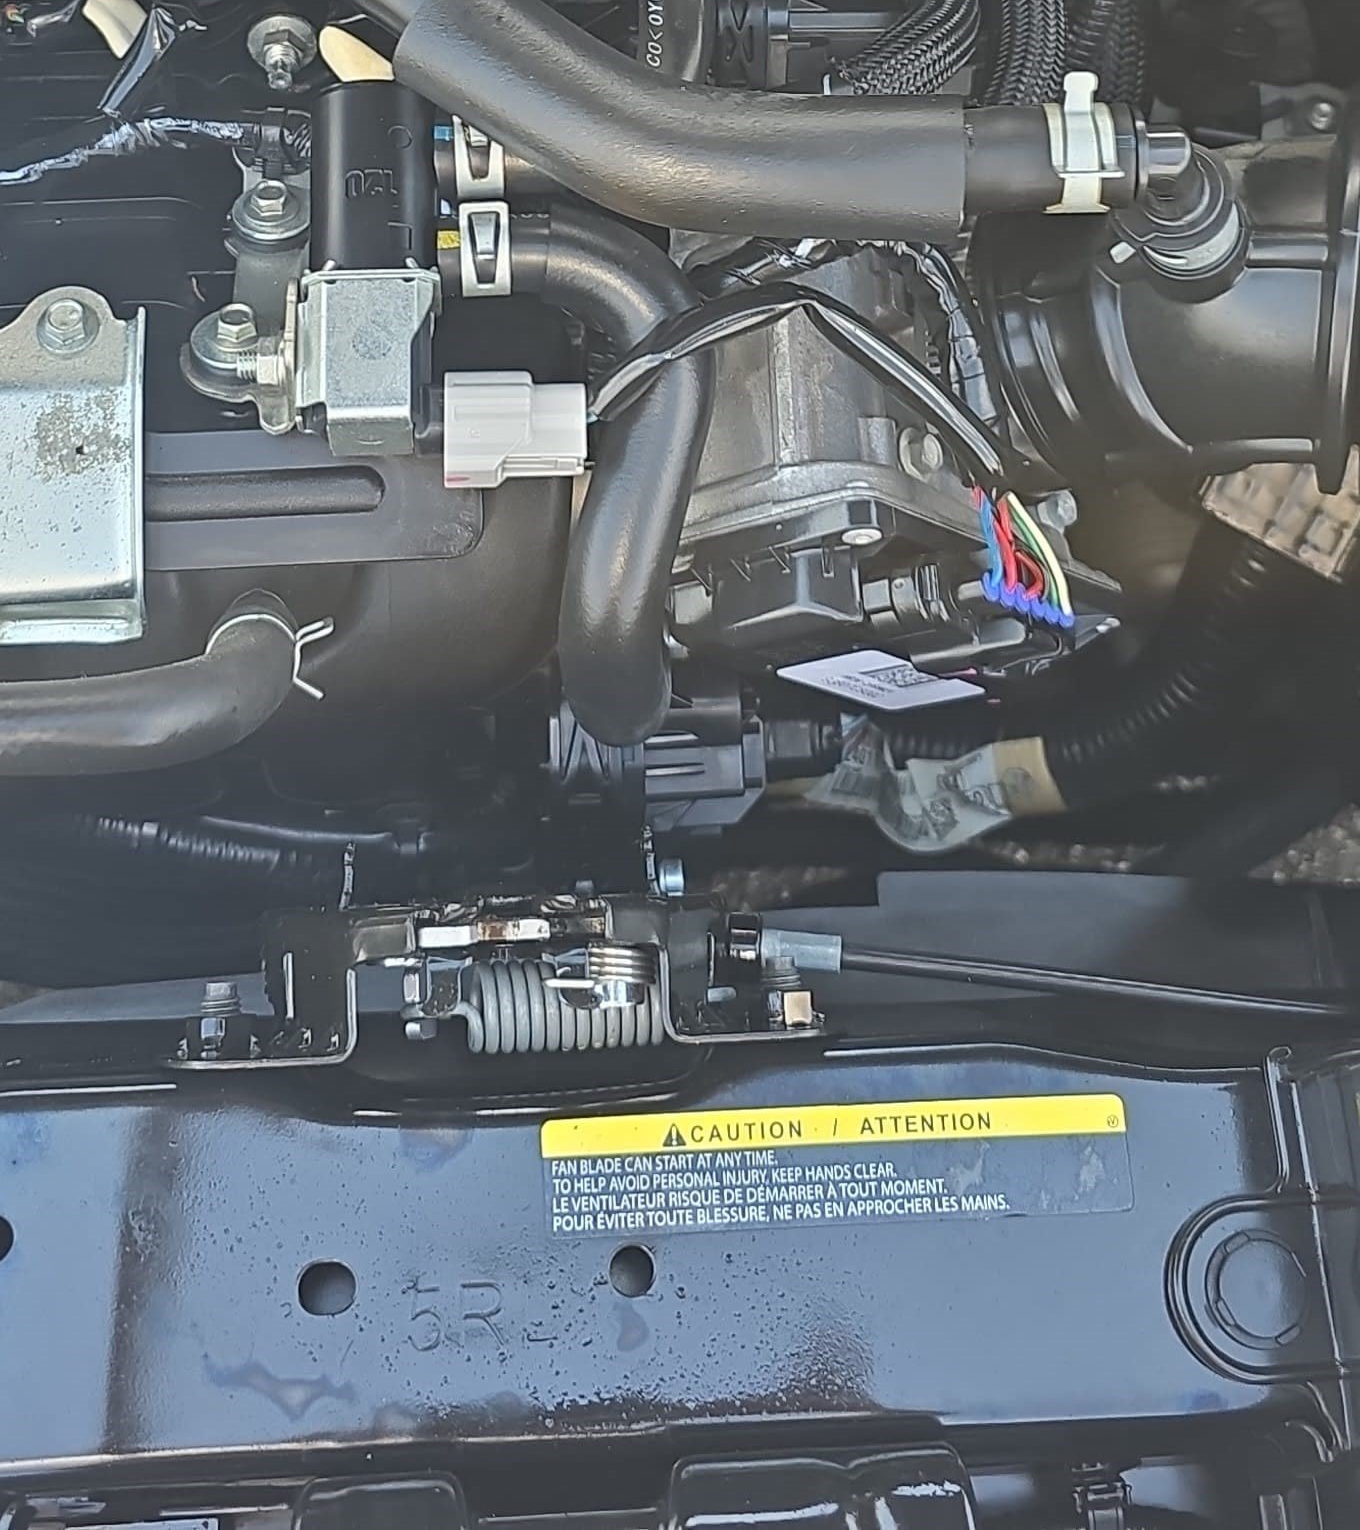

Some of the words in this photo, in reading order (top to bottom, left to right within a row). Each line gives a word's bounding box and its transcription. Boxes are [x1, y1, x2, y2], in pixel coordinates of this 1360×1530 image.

[691, 1120, 802, 1143] CAUTION
[860, 1112, 992, 1135] ATTENTION
[552, 1160, 577, 1176] FAN
[580, 1157, 621, 1174] BLADE
[624, 1155, 653, 1172] CAN
[655, 1153, 694, 1170] START
[696, 1152, 713, 1169] AT
[715, 1151, 742, 1168] ANY
[743, 1149, 778, 1166] TIME.
[553, 1178, 572, 1195] TO
[574, 1176, 606, 1194] HELP
[609, 1174, 650, 1191] AVOID
[653, 1171, 720, 1189] PERSONAL
[723, 1168, 770, 1186] INJURY,
[772, 1166, 803, 1183] KEEP
[805, 1164, 851, 1181] HANDS
[854, 1162, 897, 1179] CLEAR.
[553, 1196, 569, 1213] LE
[571, 1192, 665, 1212] VENTILATEUR
[669, 1189, 721, 1207] RISQUE
[724, 1187, 743, 1204] DE
[745, 1181, 823, 1202] DÉMARRER
[827, 1180, 838, 1199] À
[839, 1181, 879, 1198] TOUT
[881, 1178, 948, 1196] MOMENT.
[553, 1213, 594, 1232] POUR
[596, 1208, 645, 1229] ÉVITER
[646, 1208, 694, 1227] TOUTE
[696, 1204, 770, 1225] BLESSURE,
[772, 1203, 792, 1220] NE
[795, 1202, 821, 1219] PAS
[824, 1200, 845, 1218] EN
[846, 1197, 932, 1217] APPROCHER
[934, 1195, 958, 1212] LES
[960, 1193, 1010, 1211] MAINS.
